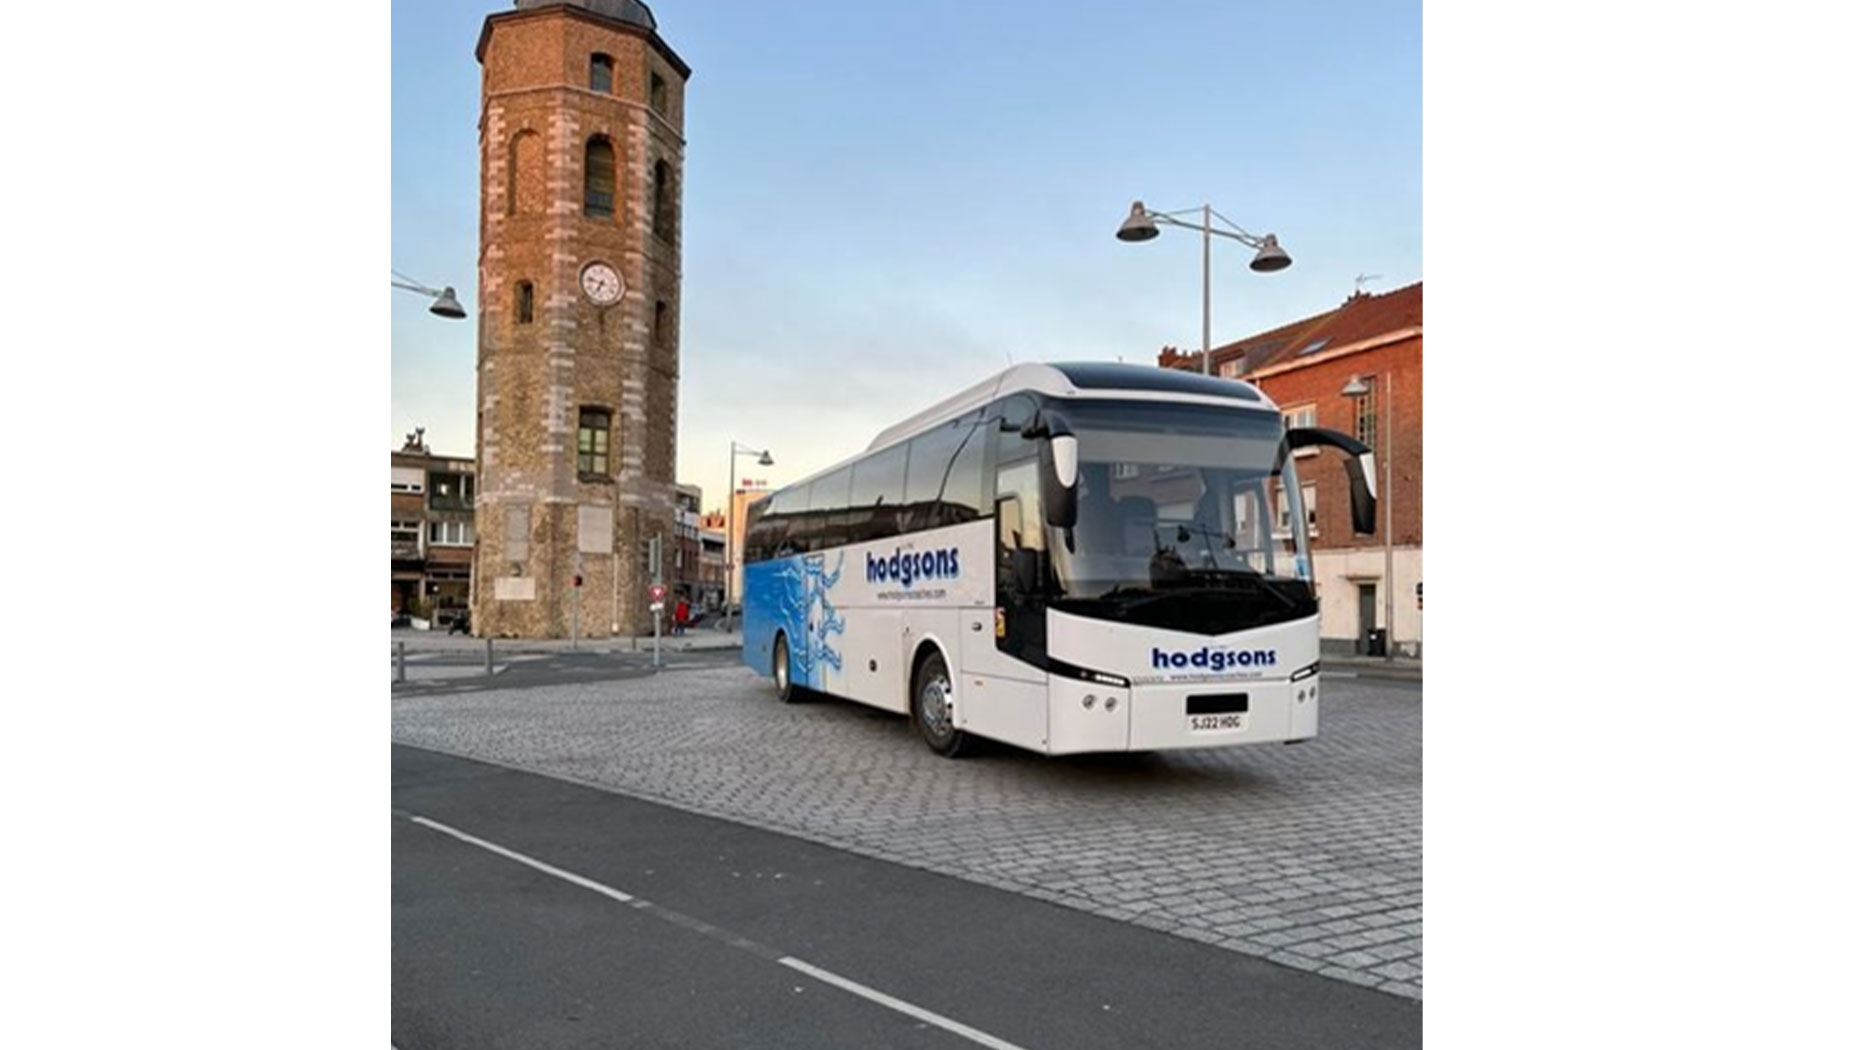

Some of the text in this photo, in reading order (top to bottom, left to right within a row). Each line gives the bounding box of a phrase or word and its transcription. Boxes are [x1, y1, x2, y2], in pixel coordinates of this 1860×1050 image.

[866, 546, 959, 588] hodgsons
[1152, 647, 1277, 671] hodgsons
[1191, 716, 1218, 730] SJ22
